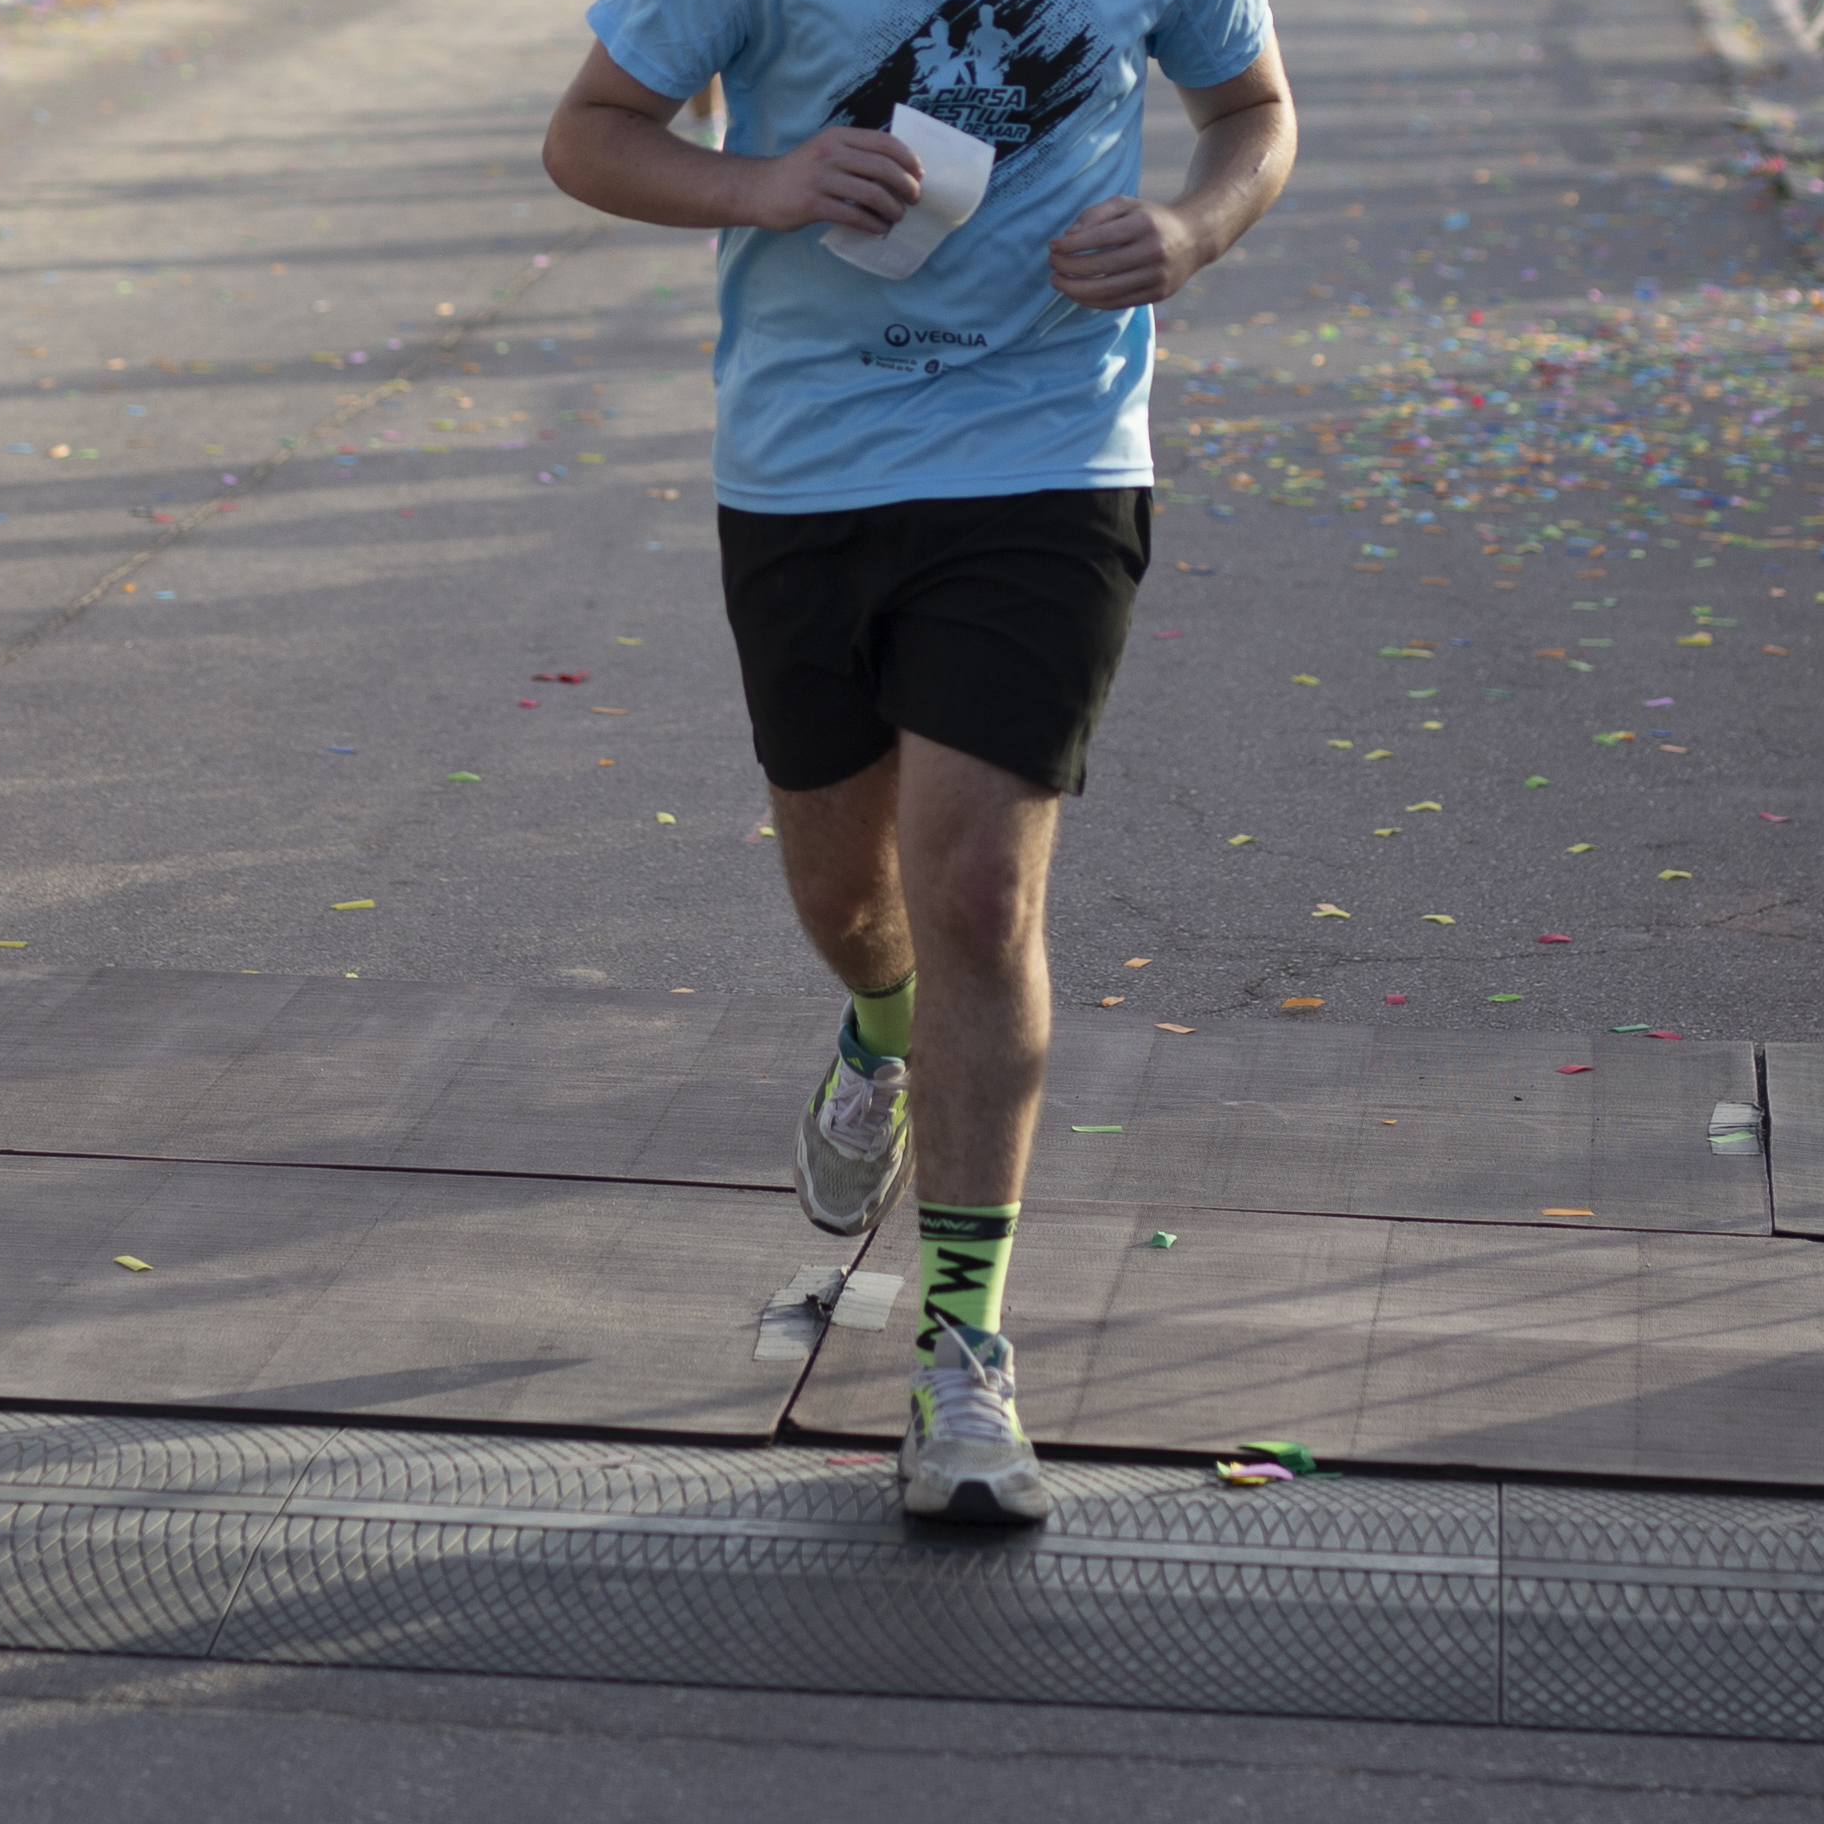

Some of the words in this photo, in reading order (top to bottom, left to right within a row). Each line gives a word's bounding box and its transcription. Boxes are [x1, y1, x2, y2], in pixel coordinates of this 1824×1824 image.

[933, 88, 1022, 108] CURSA
[983, 125, 1028, 139] MAR
[914, 330, 988, 347] VEOLIA
